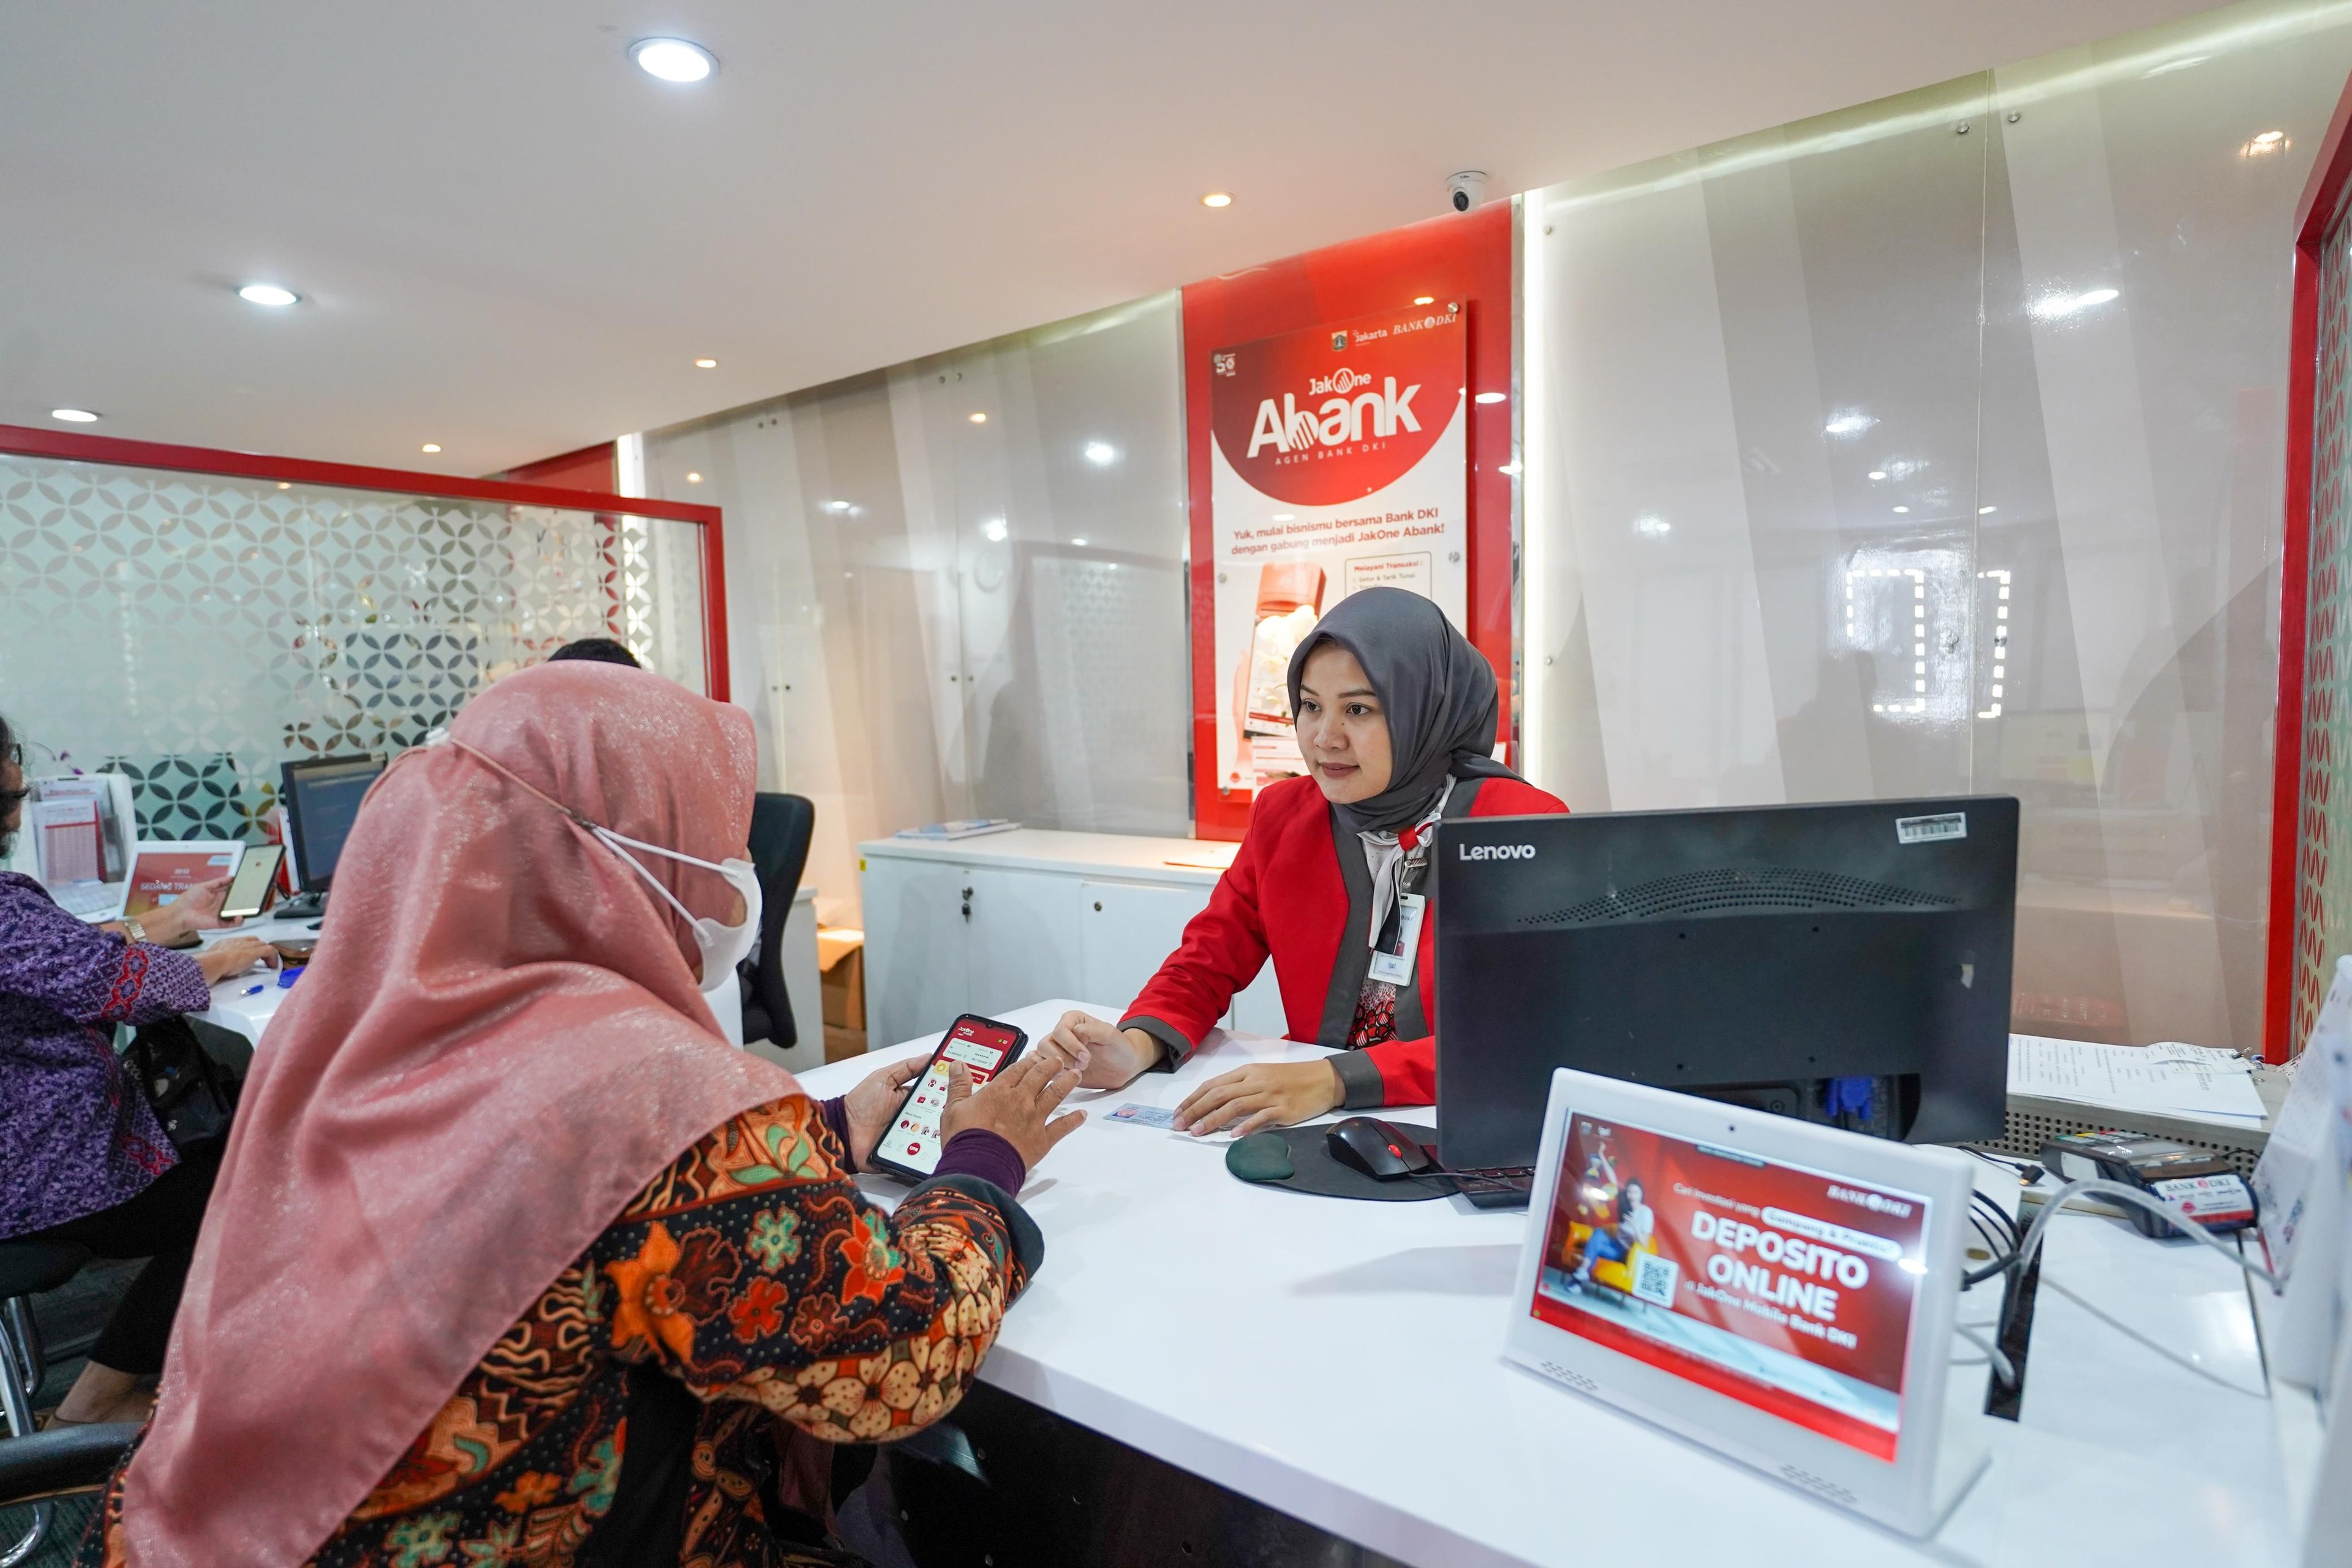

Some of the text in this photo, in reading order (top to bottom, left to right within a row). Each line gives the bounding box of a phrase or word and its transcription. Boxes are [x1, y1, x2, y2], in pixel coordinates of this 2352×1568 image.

[1355, 329, 1387, 342] Jakarta
[1393, 314, 1457, 334] BANK DKI
[1309, 368, 1371, 396] JakOne
[1246, 376, 1422, 458] Abank
[1275, 442, 1385, 466] AGEN BANK DKI
[1234, 508, 1438, 540] Yuk, mulai bisnismu bersama Bank DKI
[1231, 523, 1444, 554] dengan gabung menjadi JakOne Abank!
[1386, 560, 1419, 569] Transaksi
[1459, 843, 1536, 861] Lenovo
[1827, 1185, 1868, 1207] BANK
[2165, 1178, 2231, 1191] BANK DKI
[1691, 1210, 1869, 1289] DEPOSITO
[1707, 1254, 1839, 1322] ONLINE
[1743, 1298, 1789, 1326] Mobile
[1789, 1313, 1826, 1338] Bank
